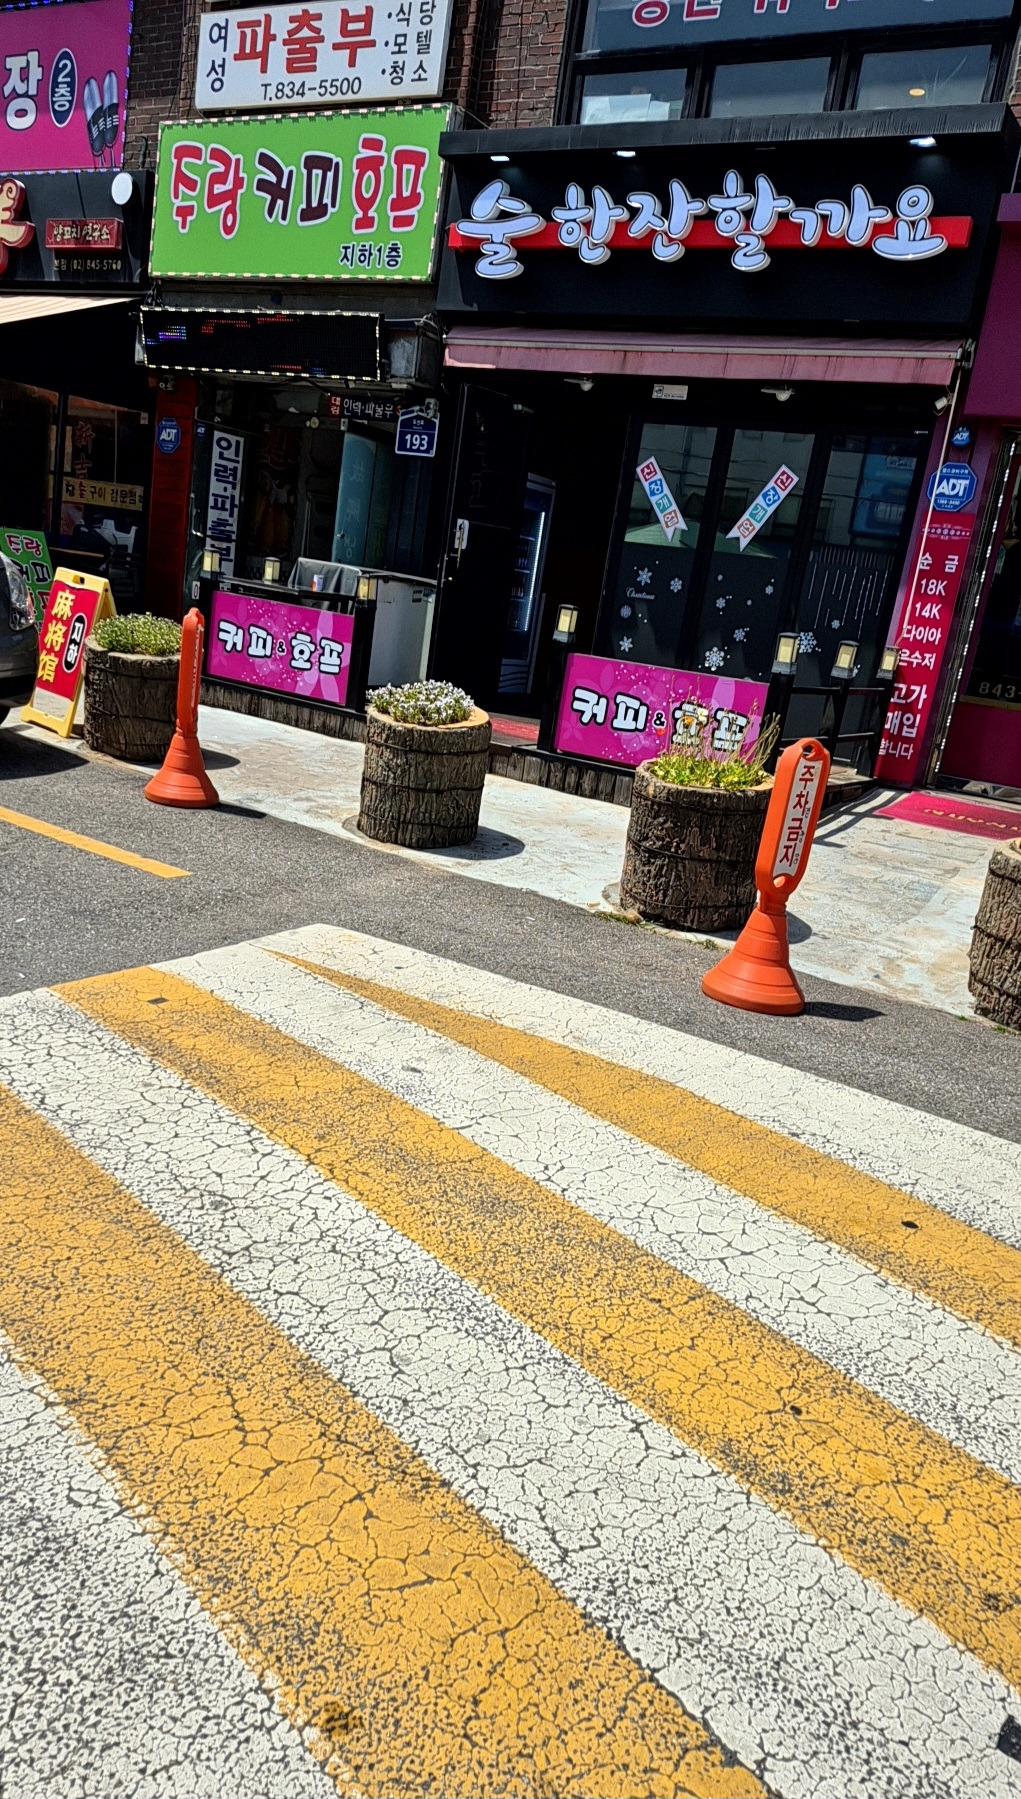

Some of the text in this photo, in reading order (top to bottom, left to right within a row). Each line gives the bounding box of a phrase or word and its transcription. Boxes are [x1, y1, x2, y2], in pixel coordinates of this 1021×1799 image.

[233, 5, 377, 74] 파출부
[390, 29, 432, 56] 모텔
[206, 18, 229, 93] 여성
[52, 59, 73, 111] 2층
[388, 60, 429, 86] 청소
[261, 77, 362, 101] T.834-5500
[253, 148, 342, 226] 커피
[352, 133, 430, 235] 호프
[339, 242, 402, 269] 지하1층
[160, 428, 177, 442] ADT
[405, 433, 429, 451] 193
[953, 432, 970, 441] ADT
[641, 462, 680, 529] 신장개업
[935, 478, 969, 497] ADT
[737, 470, 794, 539] 신장개업
[920, 578, 947, 596] 18K
[915, 601, 942, 620] 14K
[37, 589, 76, 683] 麻将馆
[66, 621, 84, 664] 지하
[903, 624, 942, 645] 다이아
[890, 683, 927, 709] 고가
[884, 710, 920, 738] 매입
[779, 765, 815, 867] 주차금지
